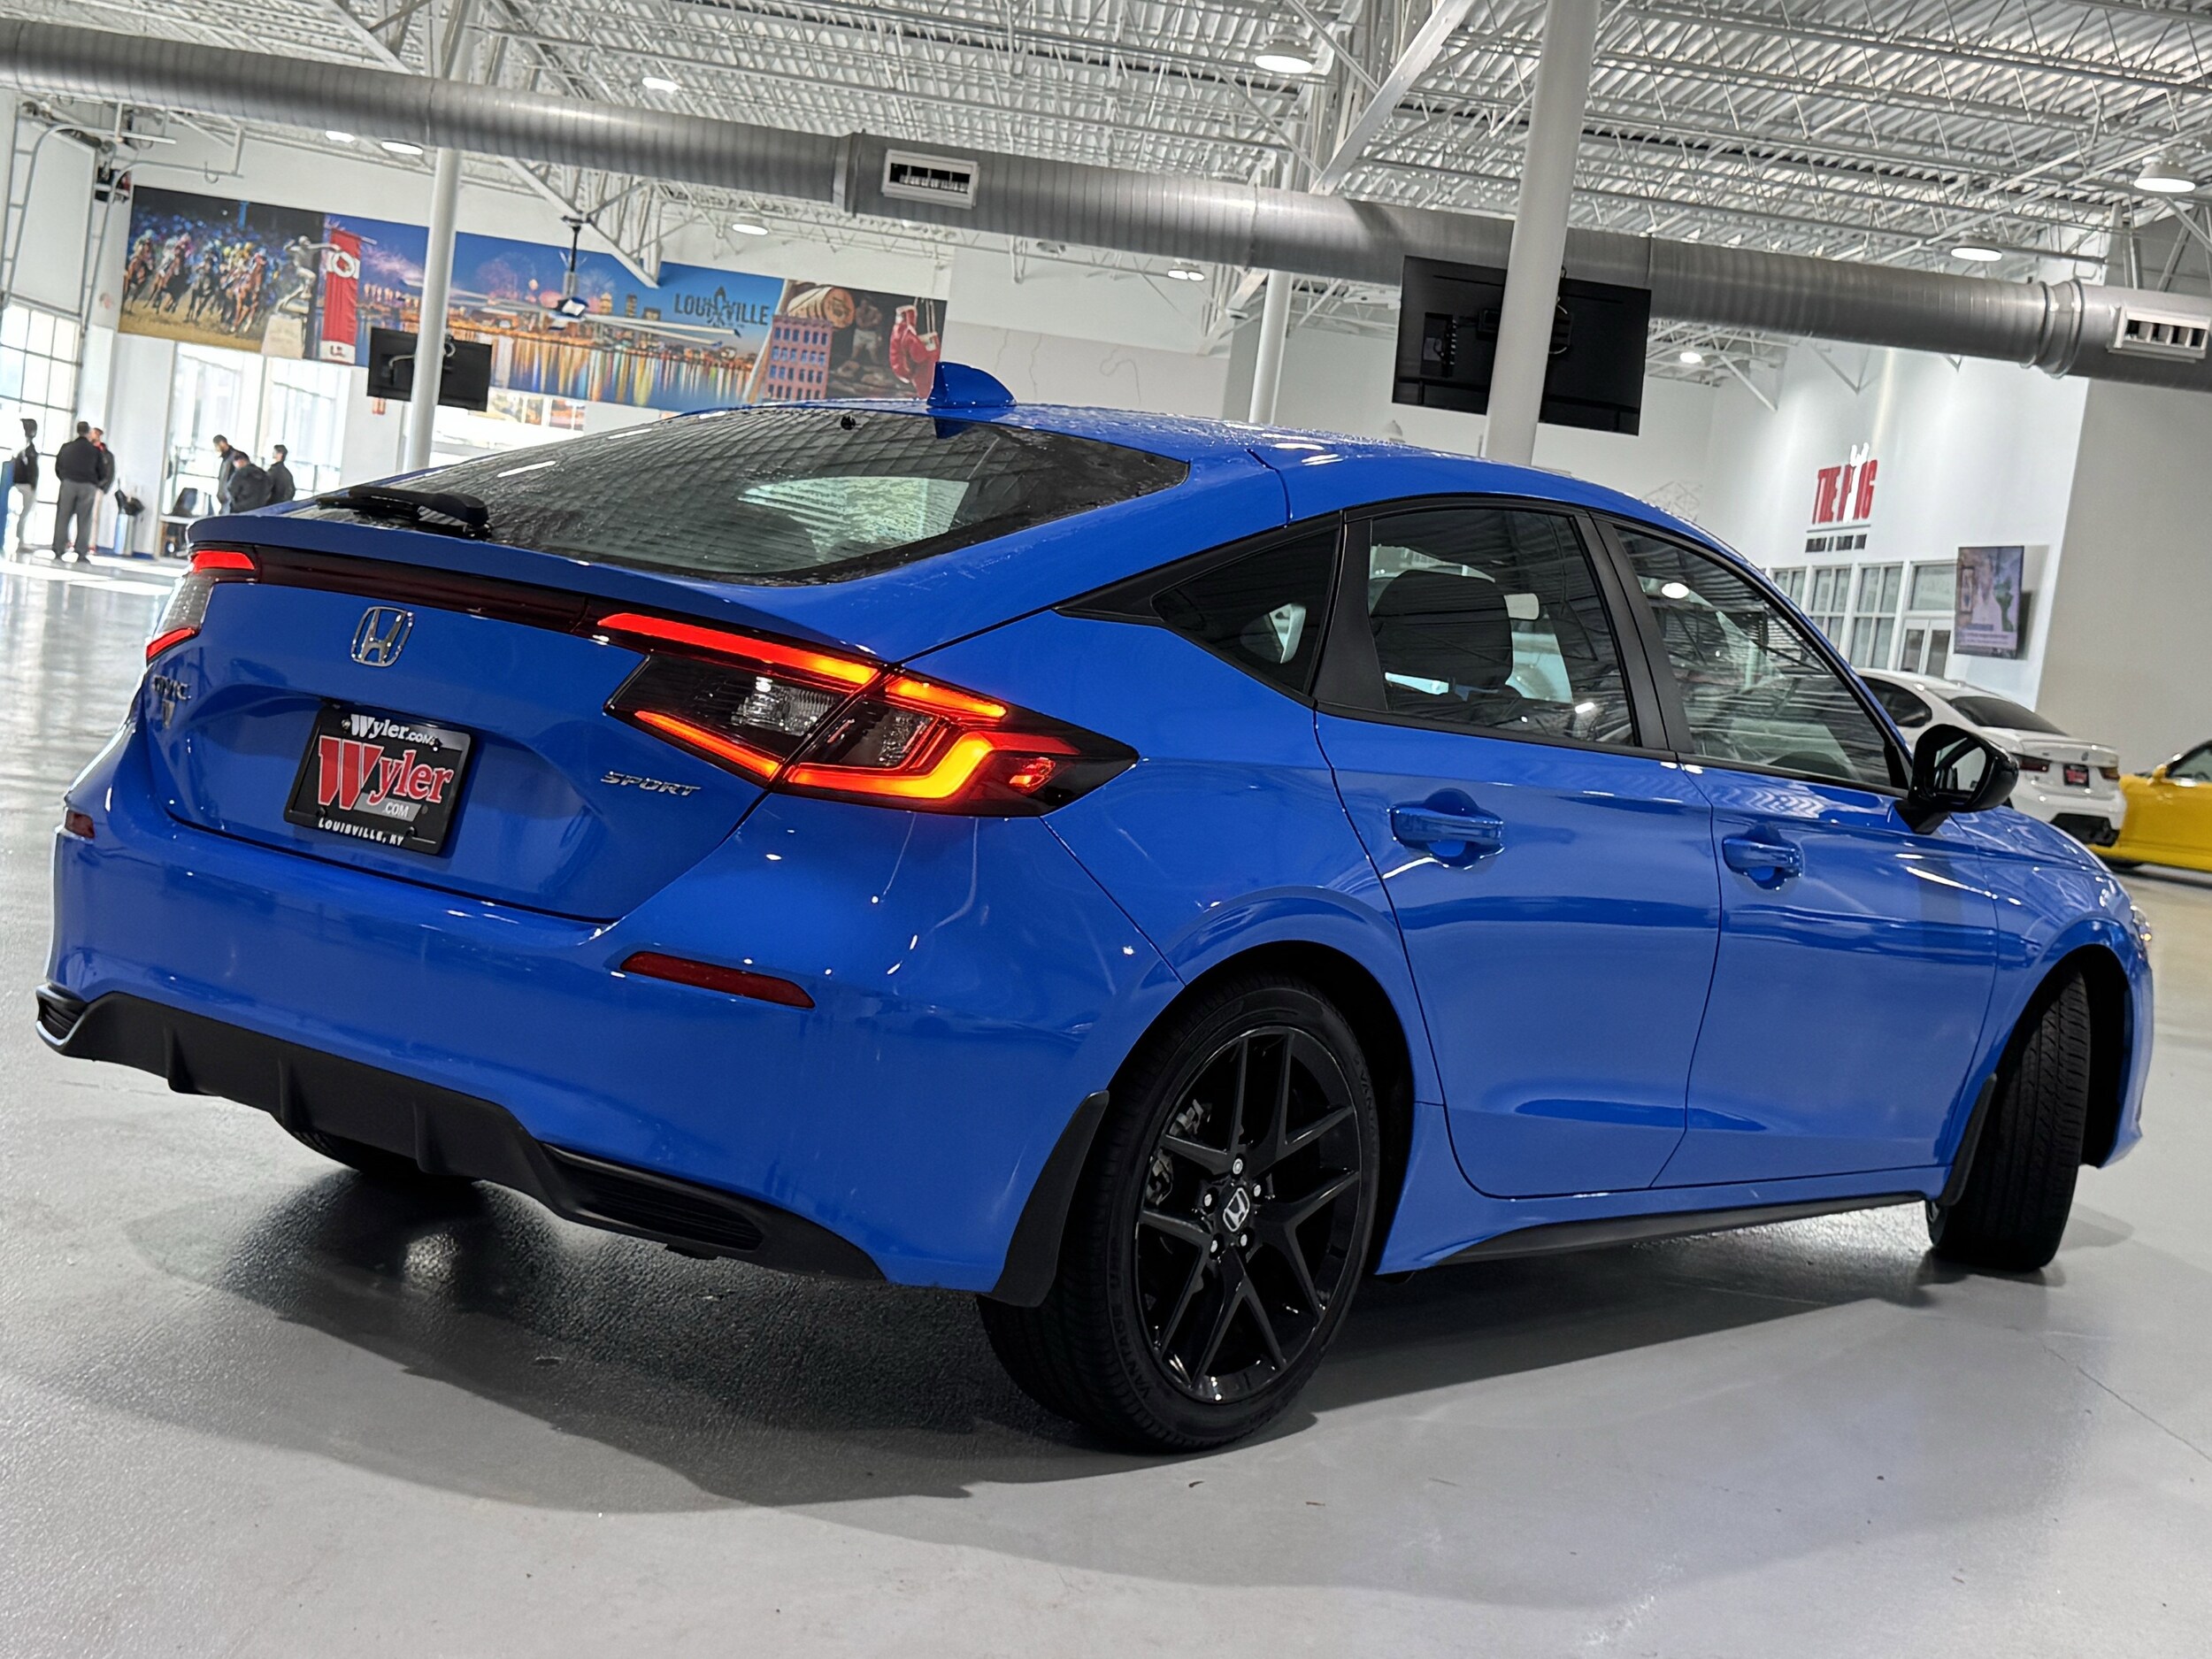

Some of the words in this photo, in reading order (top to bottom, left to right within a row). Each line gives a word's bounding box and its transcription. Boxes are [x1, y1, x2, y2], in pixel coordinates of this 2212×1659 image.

[674, 288, 770, 326] LOUIVILLE
[318, 734, 454, 810] Wyler
[601, 771, 702, 796] SPORT
[318, 817, 387, 843] LOUISVILLE,
